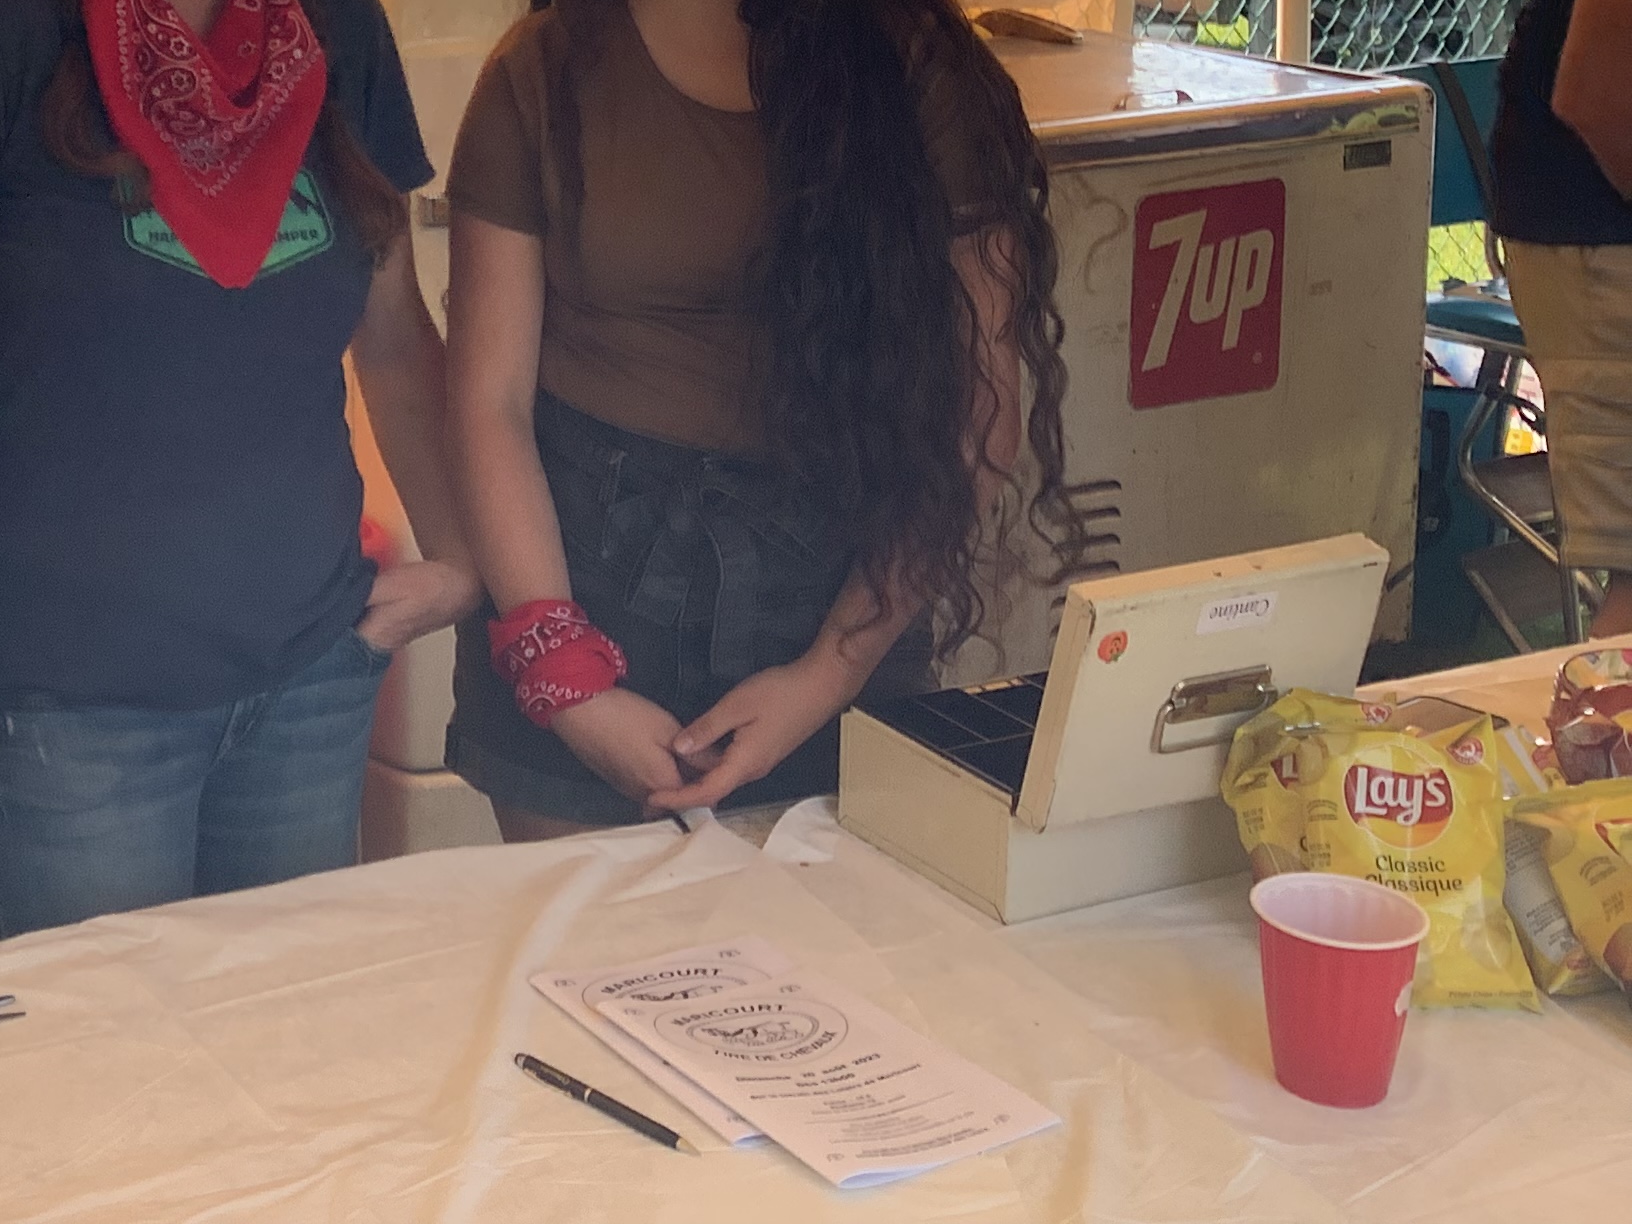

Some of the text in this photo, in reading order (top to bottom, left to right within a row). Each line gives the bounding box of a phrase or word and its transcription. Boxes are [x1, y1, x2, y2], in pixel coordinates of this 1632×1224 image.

[1210, 599, 1269, 621] Cantine
[1354, 765, 1447, 827] Lay's
[1376, 855, 1445, 874] Classic
[600, 967, 723, 994] MARICOURT
[671, 1004, 785, 1027] MARICOURT
